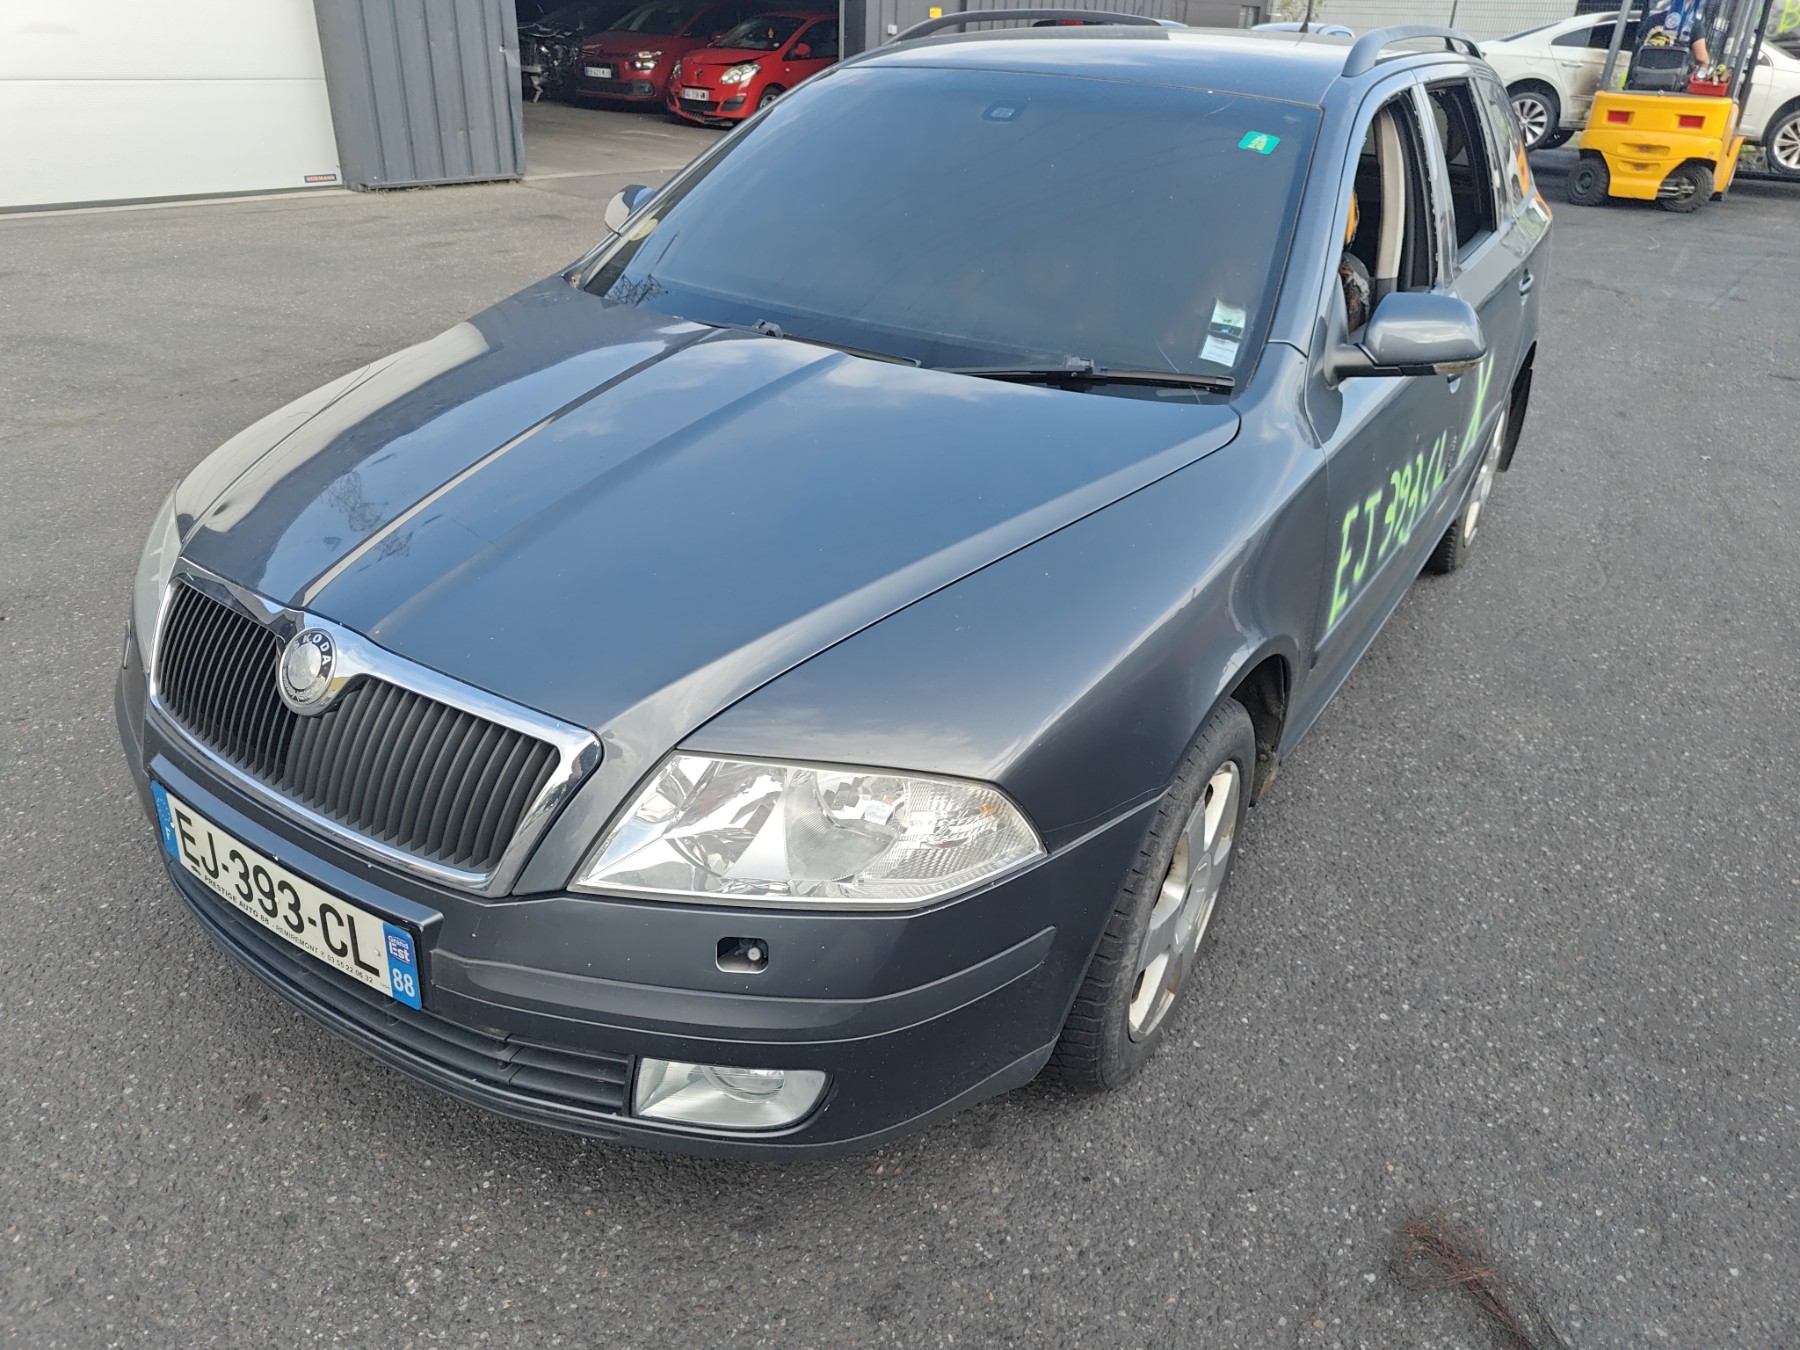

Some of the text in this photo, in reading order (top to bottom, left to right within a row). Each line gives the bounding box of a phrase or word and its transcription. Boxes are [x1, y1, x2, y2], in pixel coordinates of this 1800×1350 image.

[165, 826, 171, 840] F
[174, 807, 380, 978] EJ-393-CL
[204, 875, 238, 904] PRESTIGE
[239, 900, 259, 918] AUTO
[389, 942, 411, 962] Est
[392, 967, 416, 998] 88
